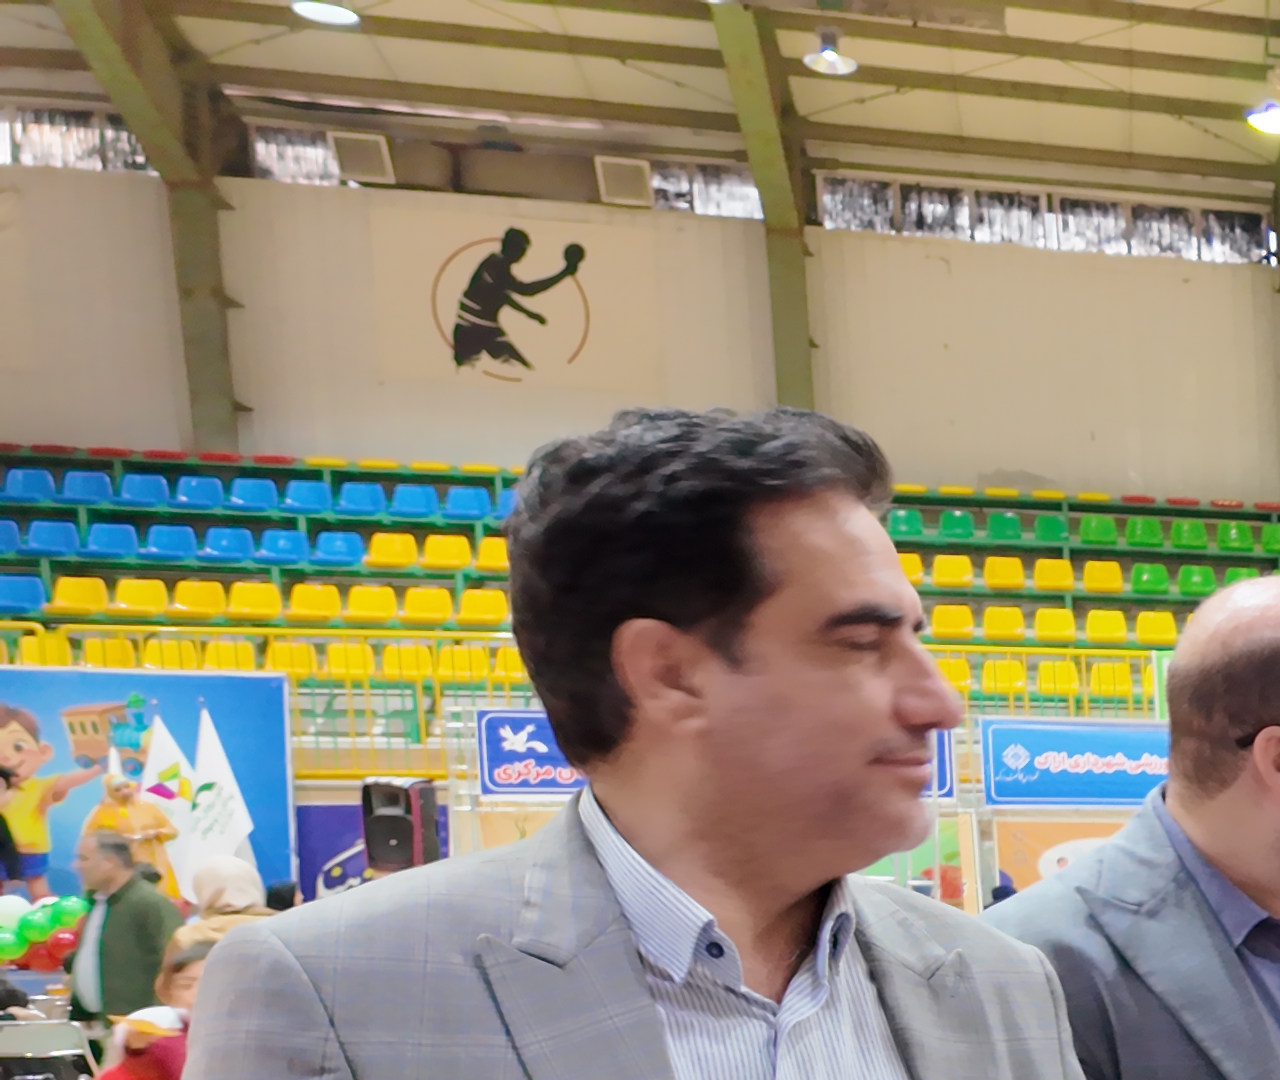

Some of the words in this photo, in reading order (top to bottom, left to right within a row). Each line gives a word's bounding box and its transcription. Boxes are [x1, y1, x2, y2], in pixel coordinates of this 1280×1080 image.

[495, 759, 554, 783] مرکزی
[1034, 751, 1067, 773] اراک
[1069, 752, 1127, 773] شهرداری
